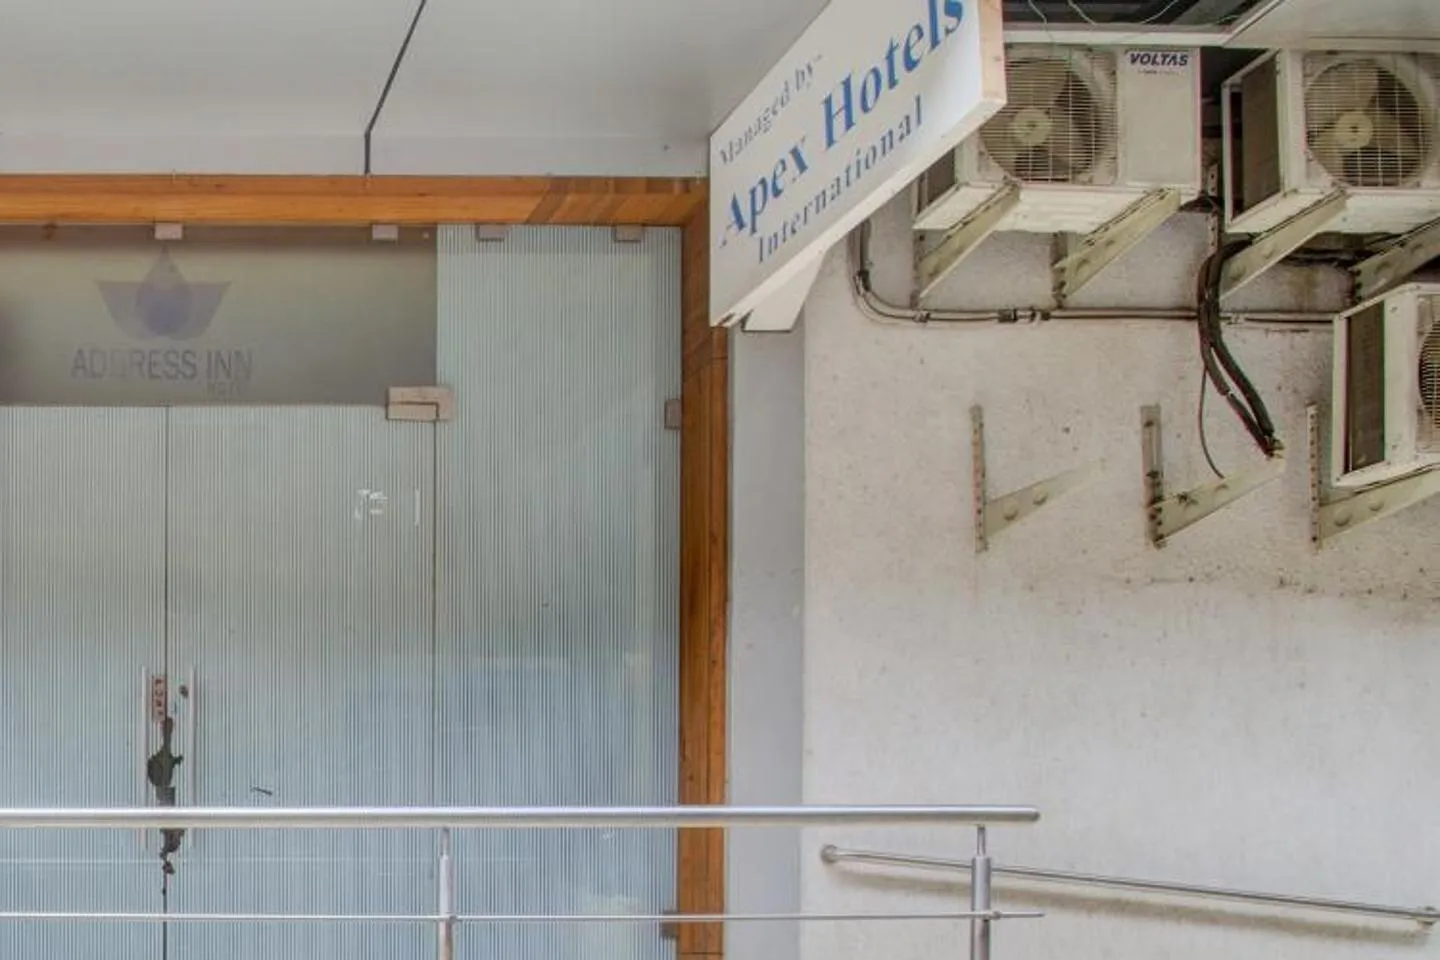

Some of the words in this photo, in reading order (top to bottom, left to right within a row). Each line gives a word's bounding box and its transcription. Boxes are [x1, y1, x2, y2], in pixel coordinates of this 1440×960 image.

[1129, 52, 1189, 66] VOLTAS
[718, 136, 809, 249] Apex
[820, 0, 964, 150] Hotels
[719, 80, 791, 165] Managed
[758, 93, 923, 264] International
[206, 349, 254, 381] INN
